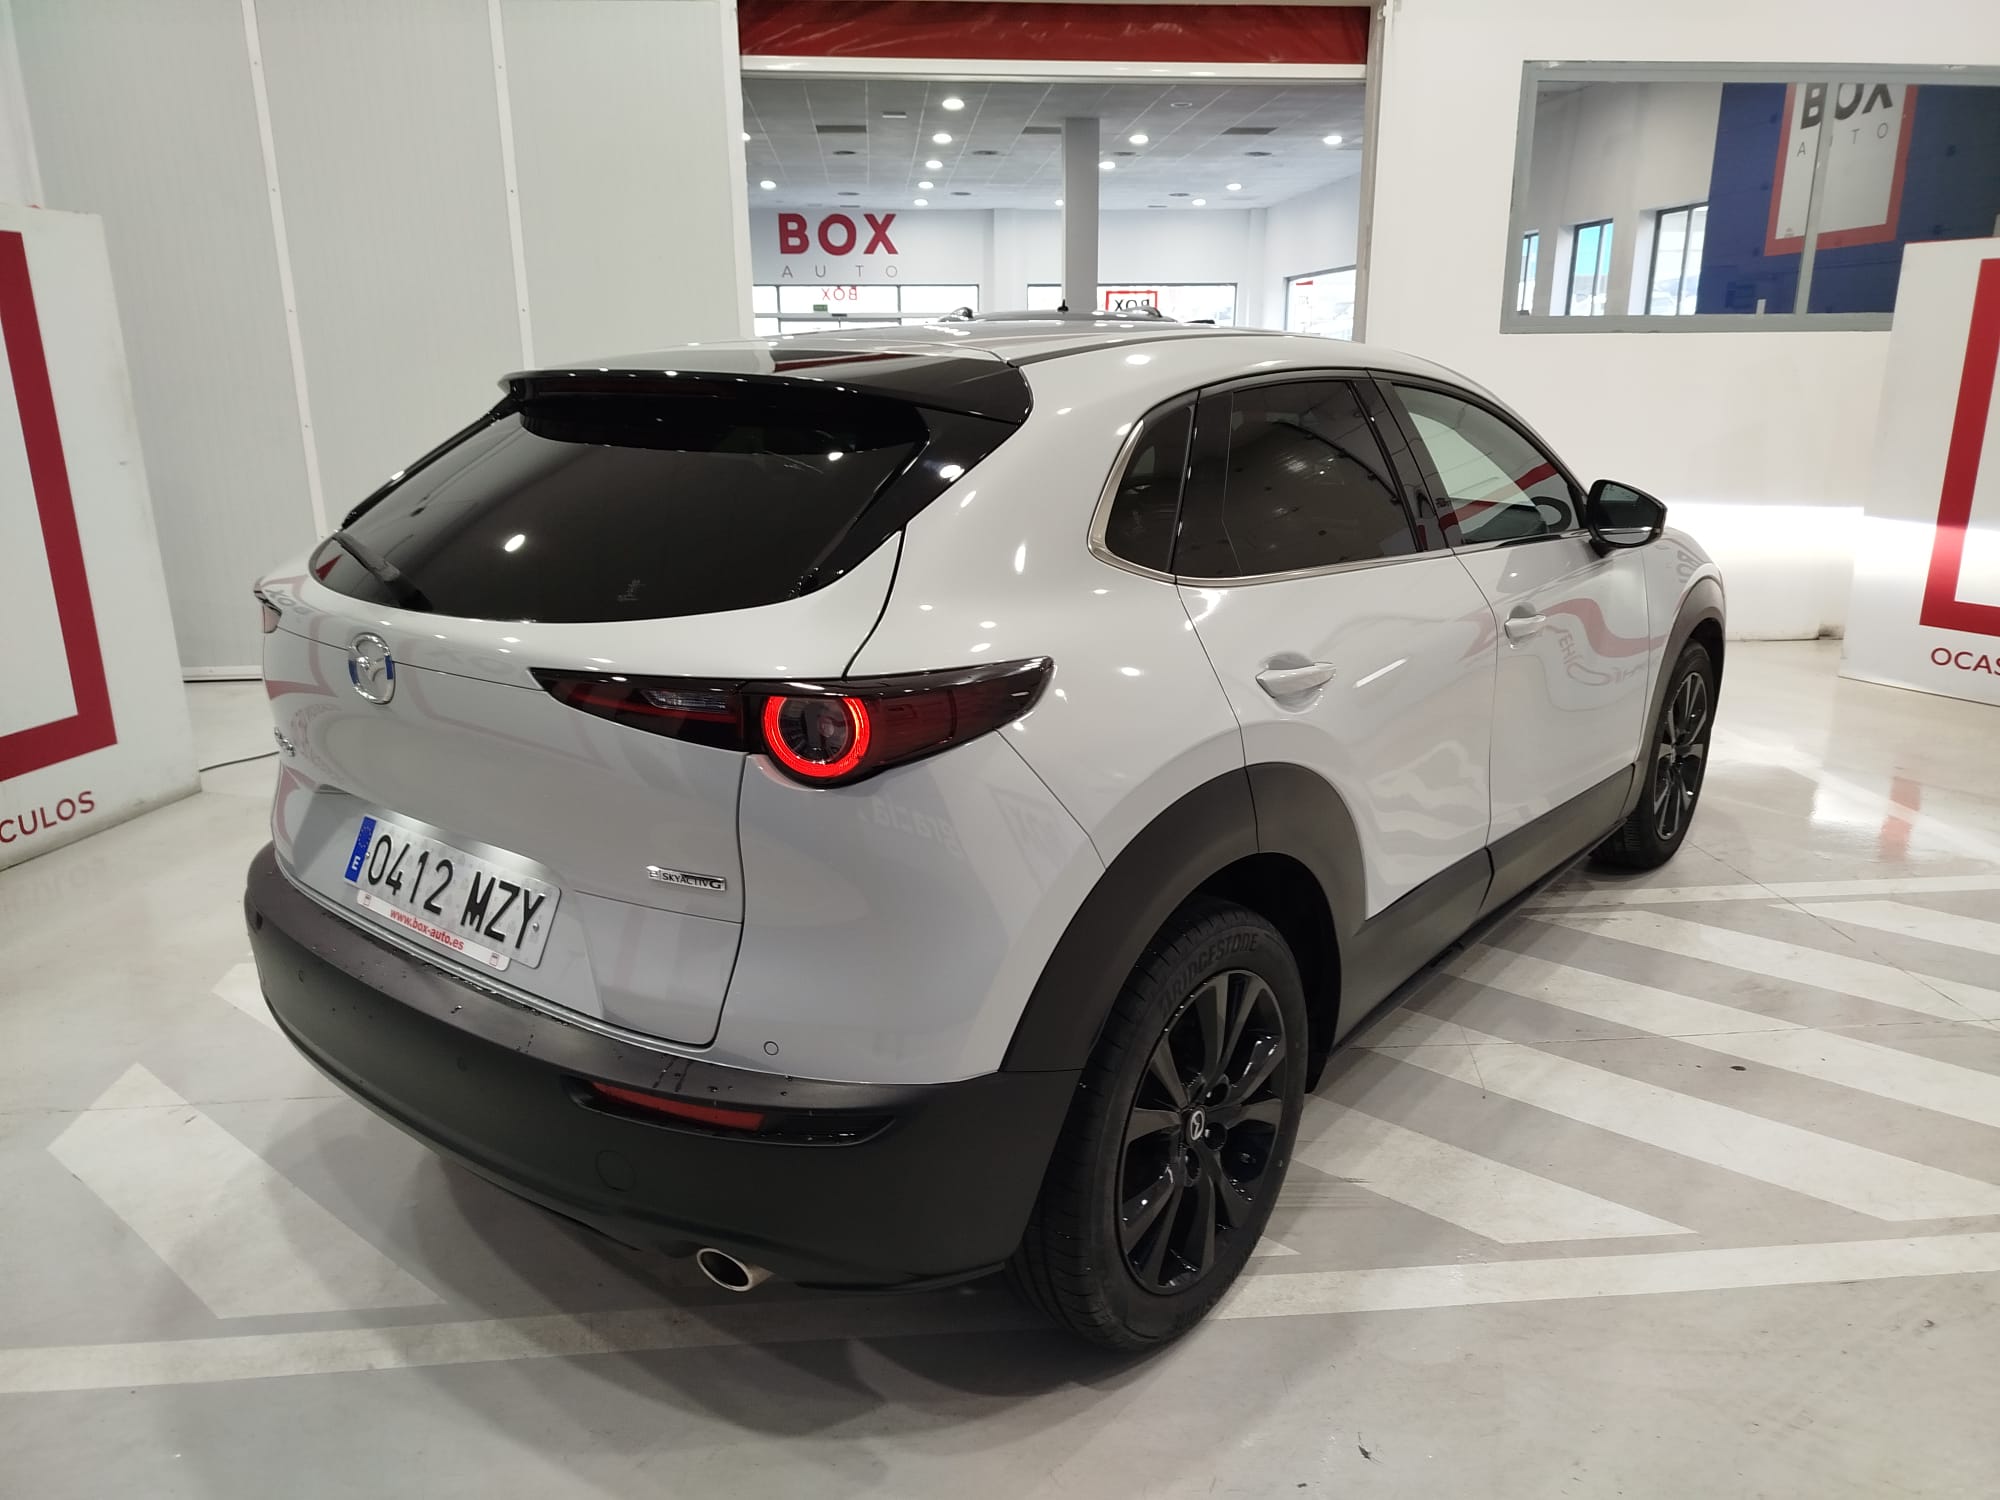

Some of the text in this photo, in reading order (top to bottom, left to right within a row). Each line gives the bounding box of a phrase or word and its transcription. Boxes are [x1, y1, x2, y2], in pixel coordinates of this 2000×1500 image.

[1797, 122, 1889, 157] ATO
[778, 213, 899, 256] BOX
[781, 265, 899, 278] AUTO
[0, 790, 95, 843] CULOS
[351, 855, 361, 871] E
[367, 834, 546, 949] 0412 MZY
[389, 908, 465, 951] www.box-auto.es
